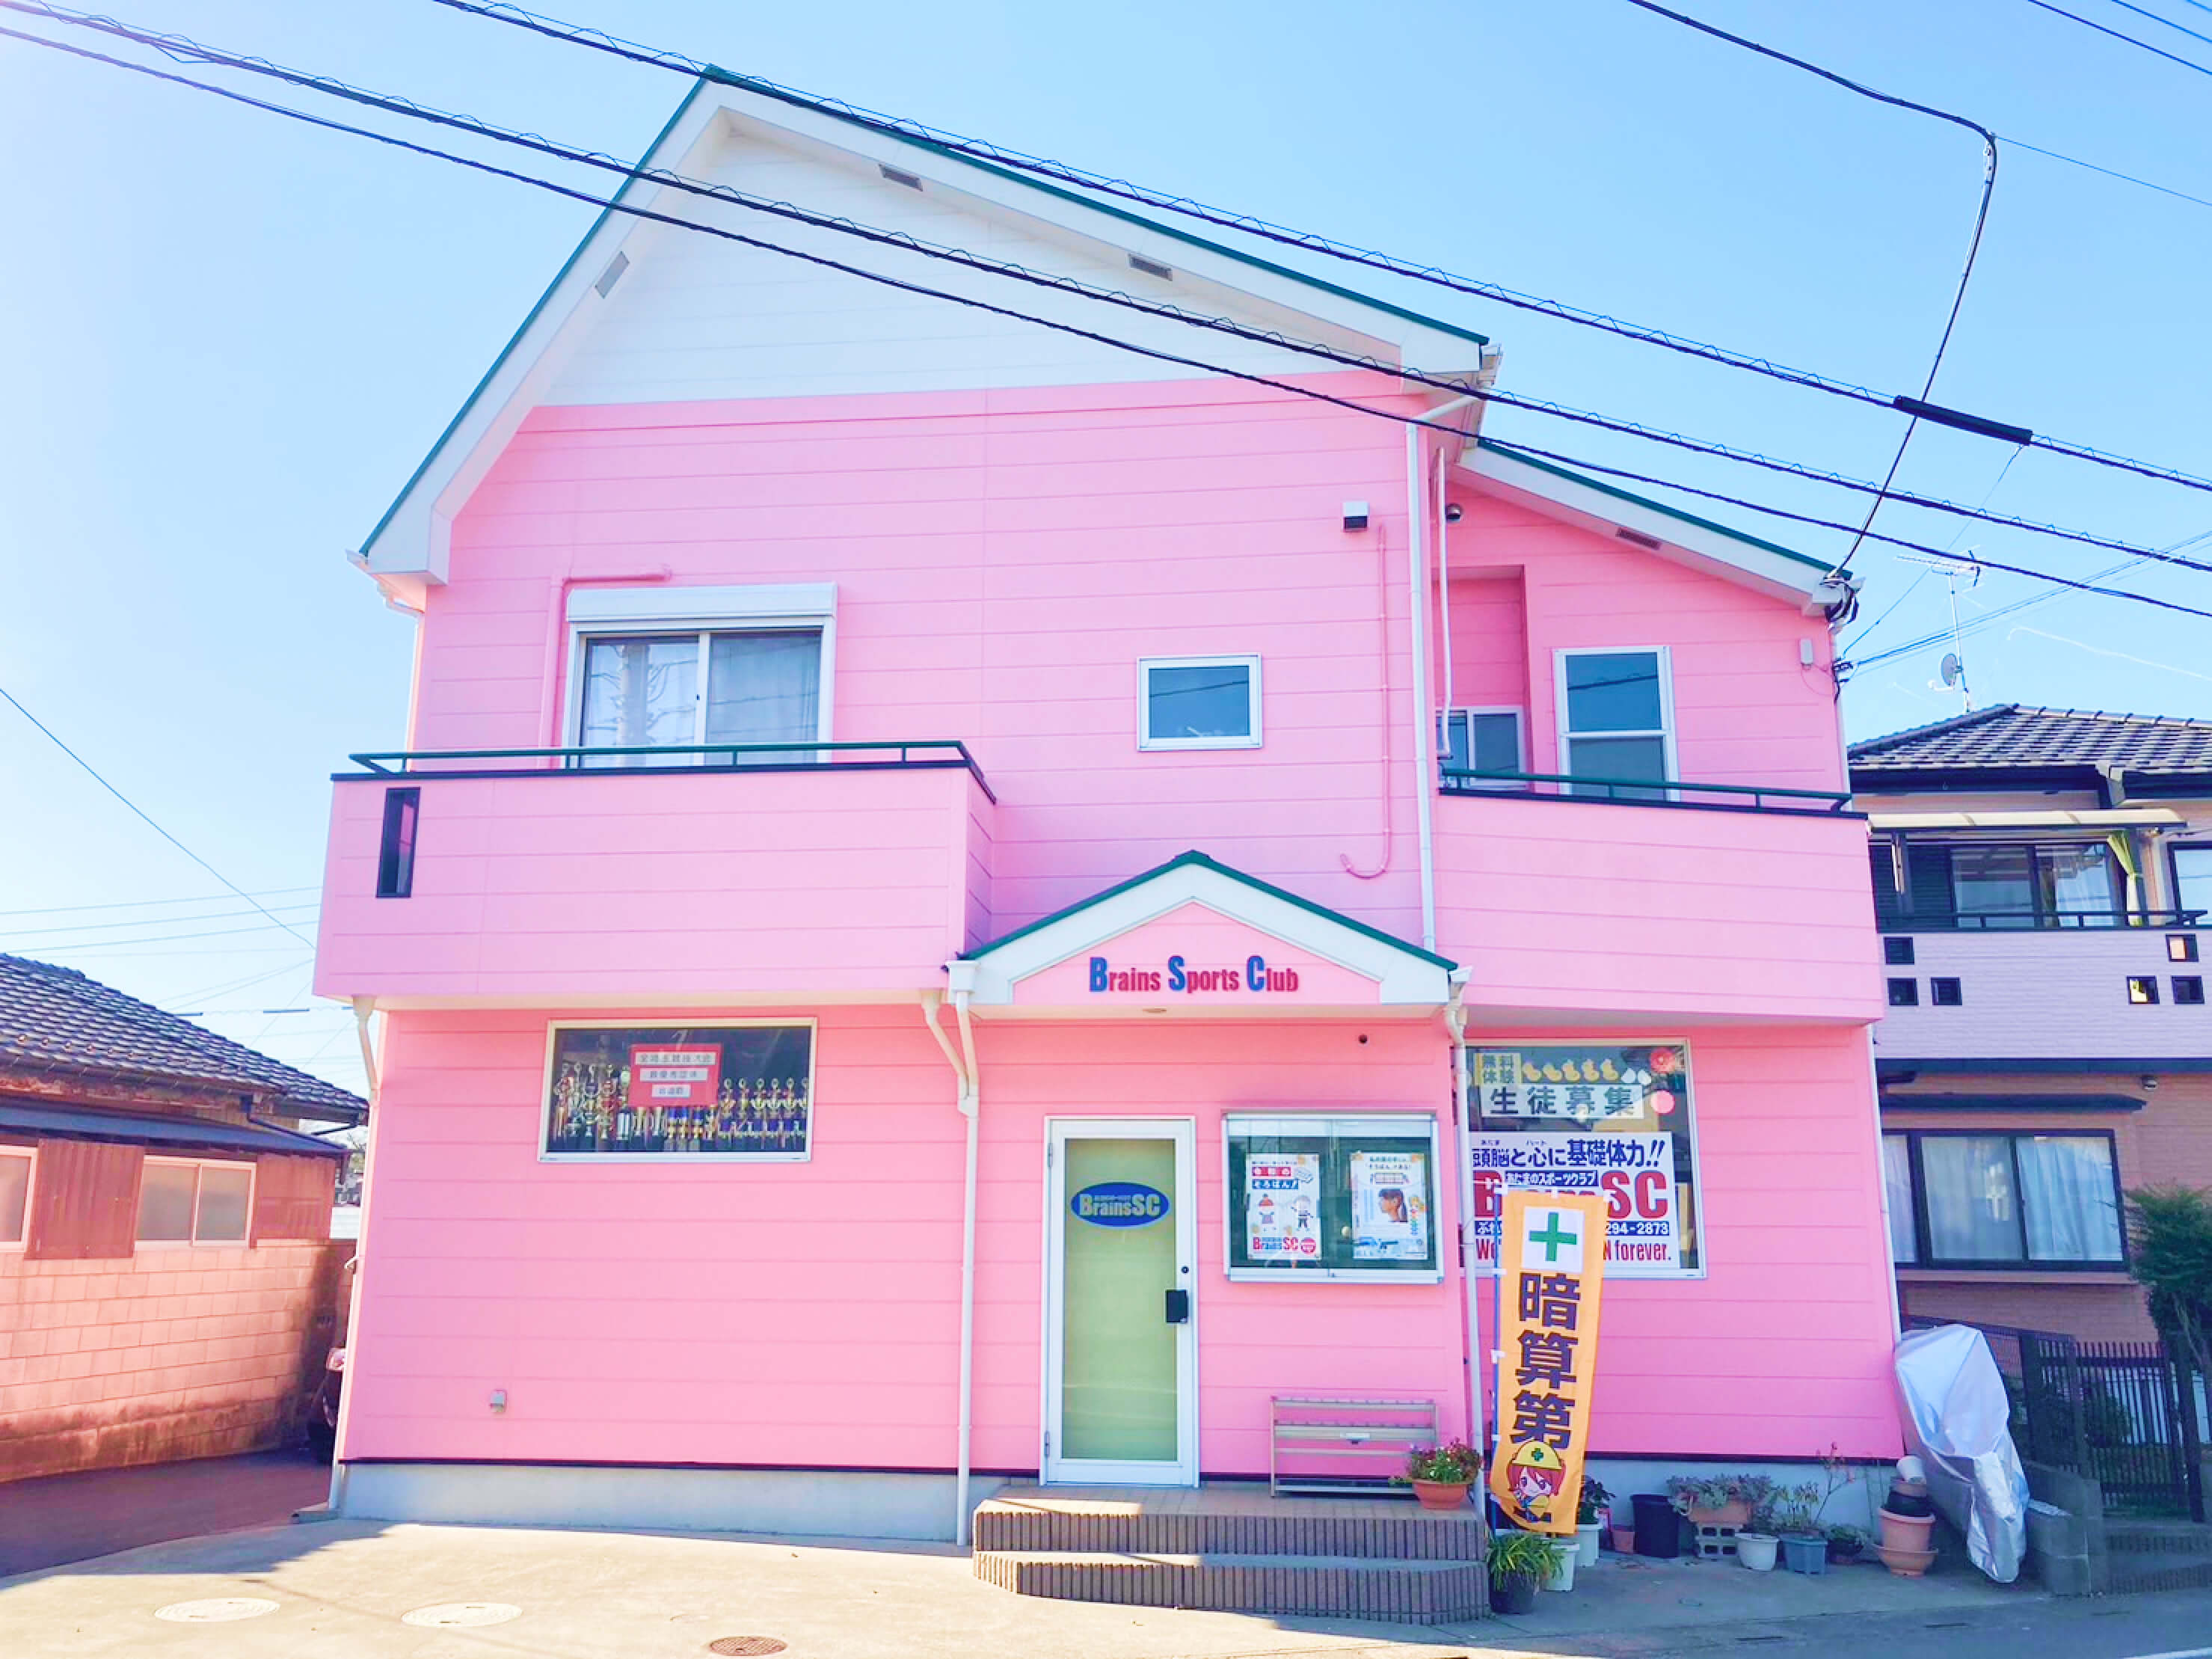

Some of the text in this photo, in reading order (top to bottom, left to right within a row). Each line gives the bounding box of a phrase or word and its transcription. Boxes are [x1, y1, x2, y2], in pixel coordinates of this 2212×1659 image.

[1090, 955, 1299, 993] Brains Sports Club
[1490, 1085, 1635, 1116] 生徒募集
[1079, 1193, 1161, 1216] BrainsSC
[1615, 1239, 1671, 1261] forever.
